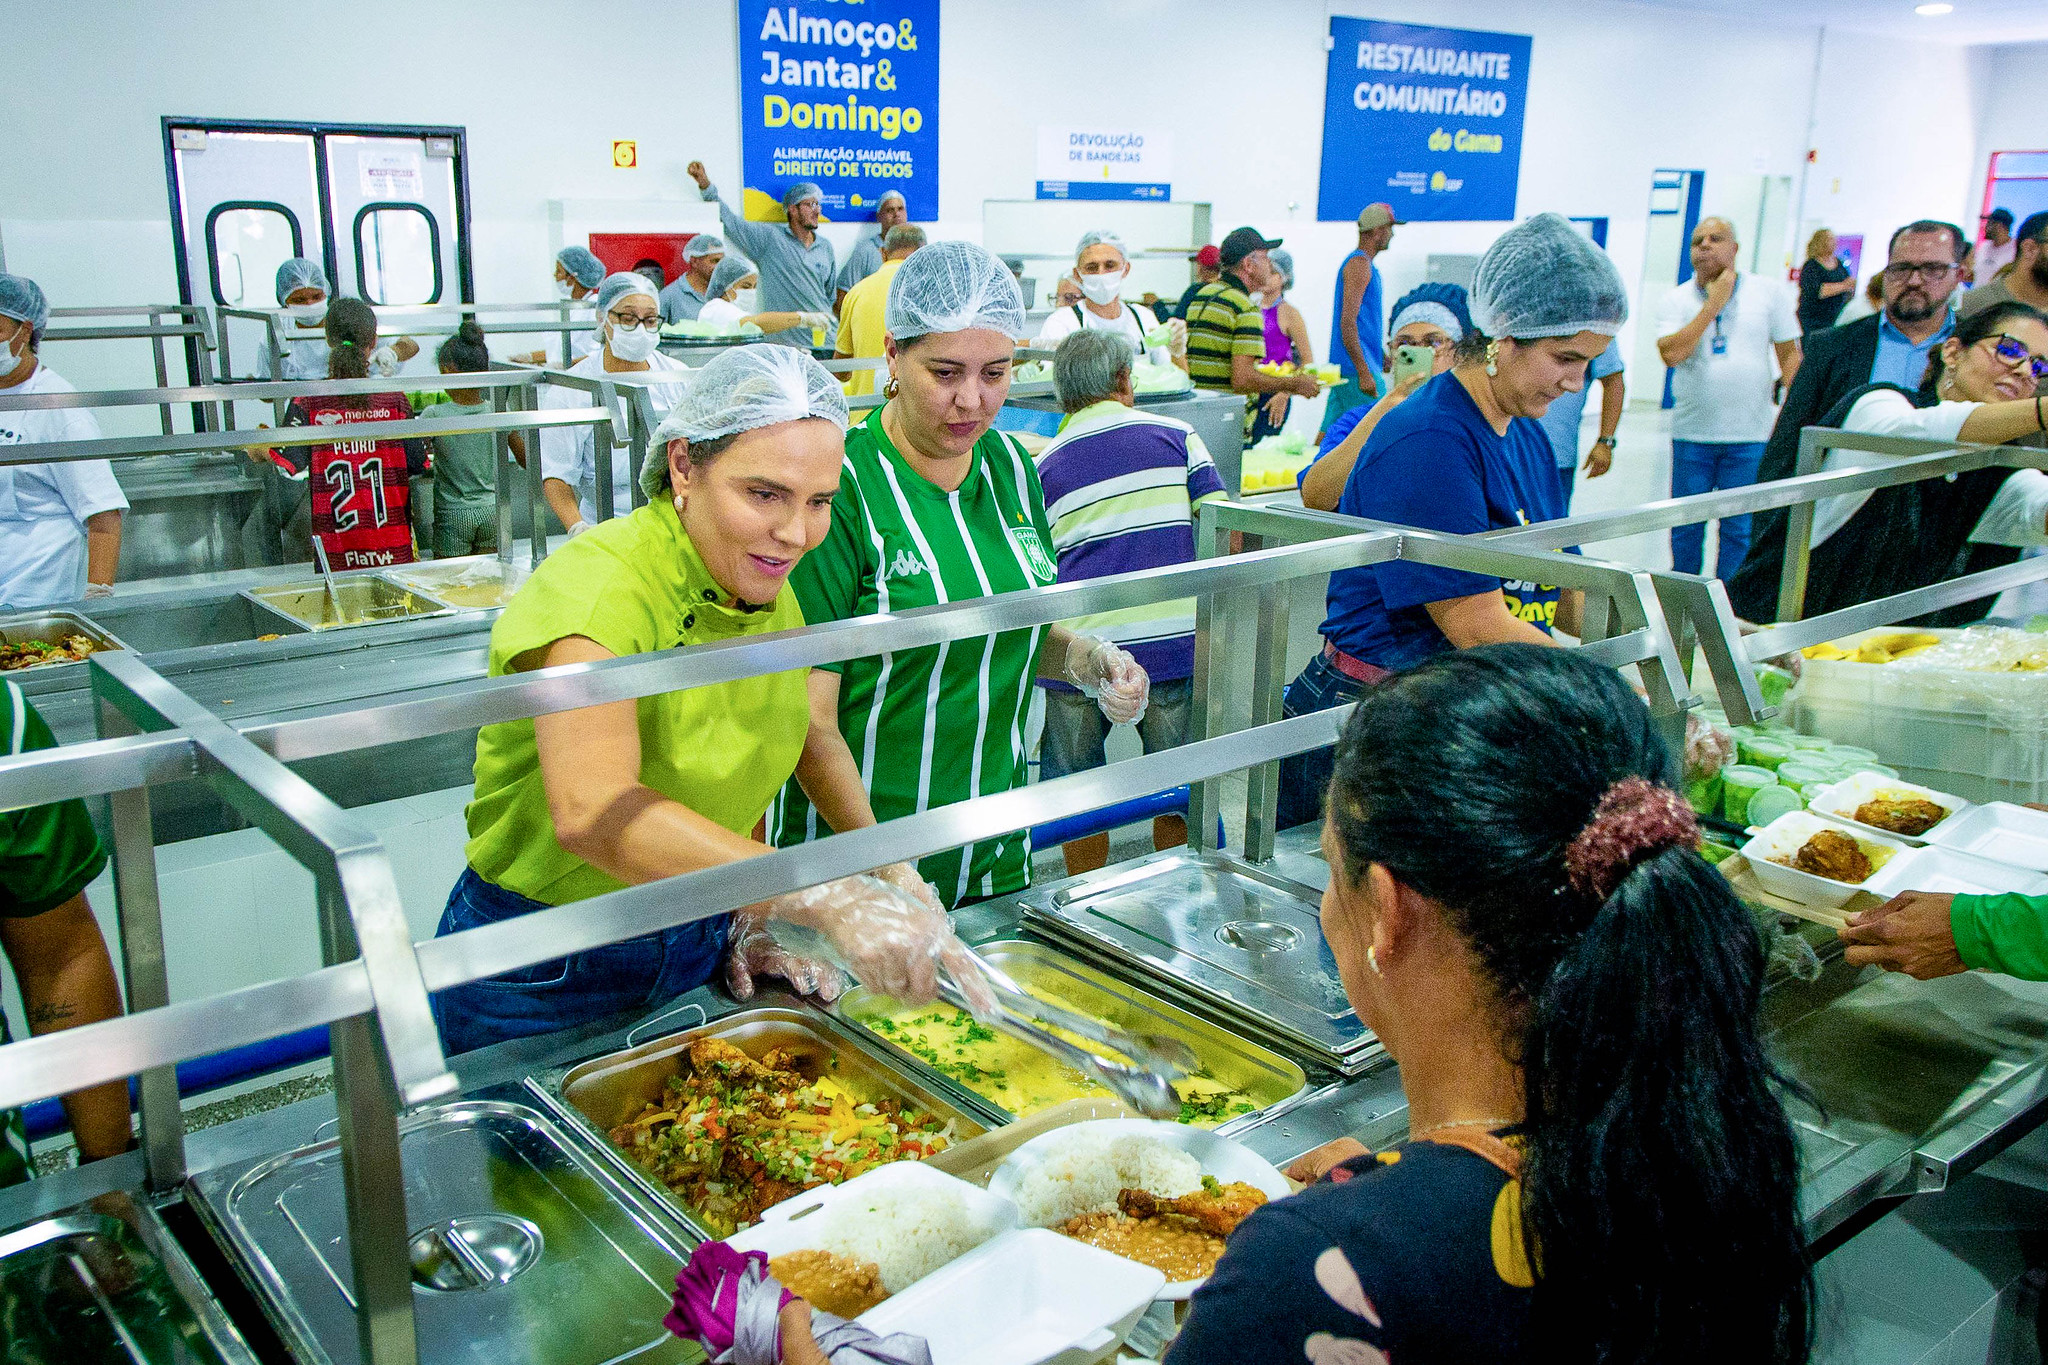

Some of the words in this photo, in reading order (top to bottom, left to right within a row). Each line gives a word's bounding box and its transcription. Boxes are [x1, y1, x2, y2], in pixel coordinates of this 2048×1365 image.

[1356, 41, 1511, 80] RESTAURANTE
[1354, 82, 1507, 118] COMUNITÁRIO
[763, 94, 923, 140] Domingo
[1069, 132, 1144, 149] DEVOLUÇÃO
[1428, 127, 1452, 152] do
[1454, 129, 1503, 153] Gama
[773, 147, 854, 163] ALIMENTAÇÃO
[856, 148, 913, 163] SAUDÁVEL
[1069, 150, 1082, 161] DE
[1086, 152, 1141, 163] BANDEJAS
[774, 161, 836, 177] DIREITO
[839, 162, 860, 178] DE
[862, 162, 914, 179] TODOS
[345, 407, 390, 420] mercado
[325, 457, 388, 533] 21
